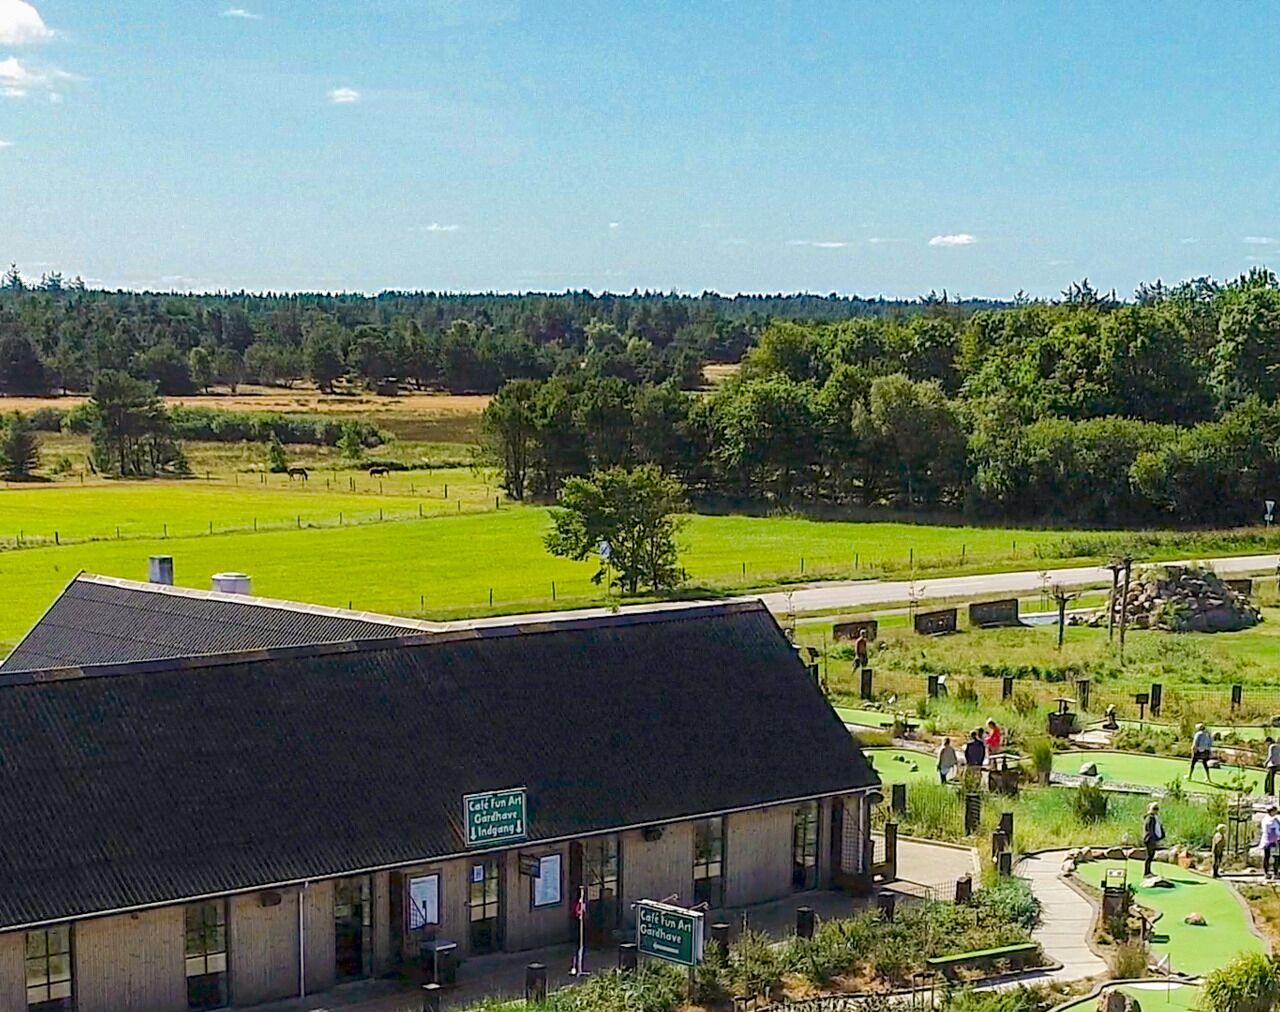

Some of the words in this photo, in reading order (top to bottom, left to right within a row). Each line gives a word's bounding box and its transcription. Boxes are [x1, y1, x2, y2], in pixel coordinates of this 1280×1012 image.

[469, 798, 489, 812] Café
[490, 797, 506, 808] Fun
[508, 796, 522, 806] Art
[474, 810, 518, 824] Gårdhave
[478, 824, 514, 837] Indgang
[640, 910, 660, 924] Café
[661, 914, 676, 928] Fun
[678, 919, 692, 932] Art
[640, 923, 682, 944] Gårdhave
